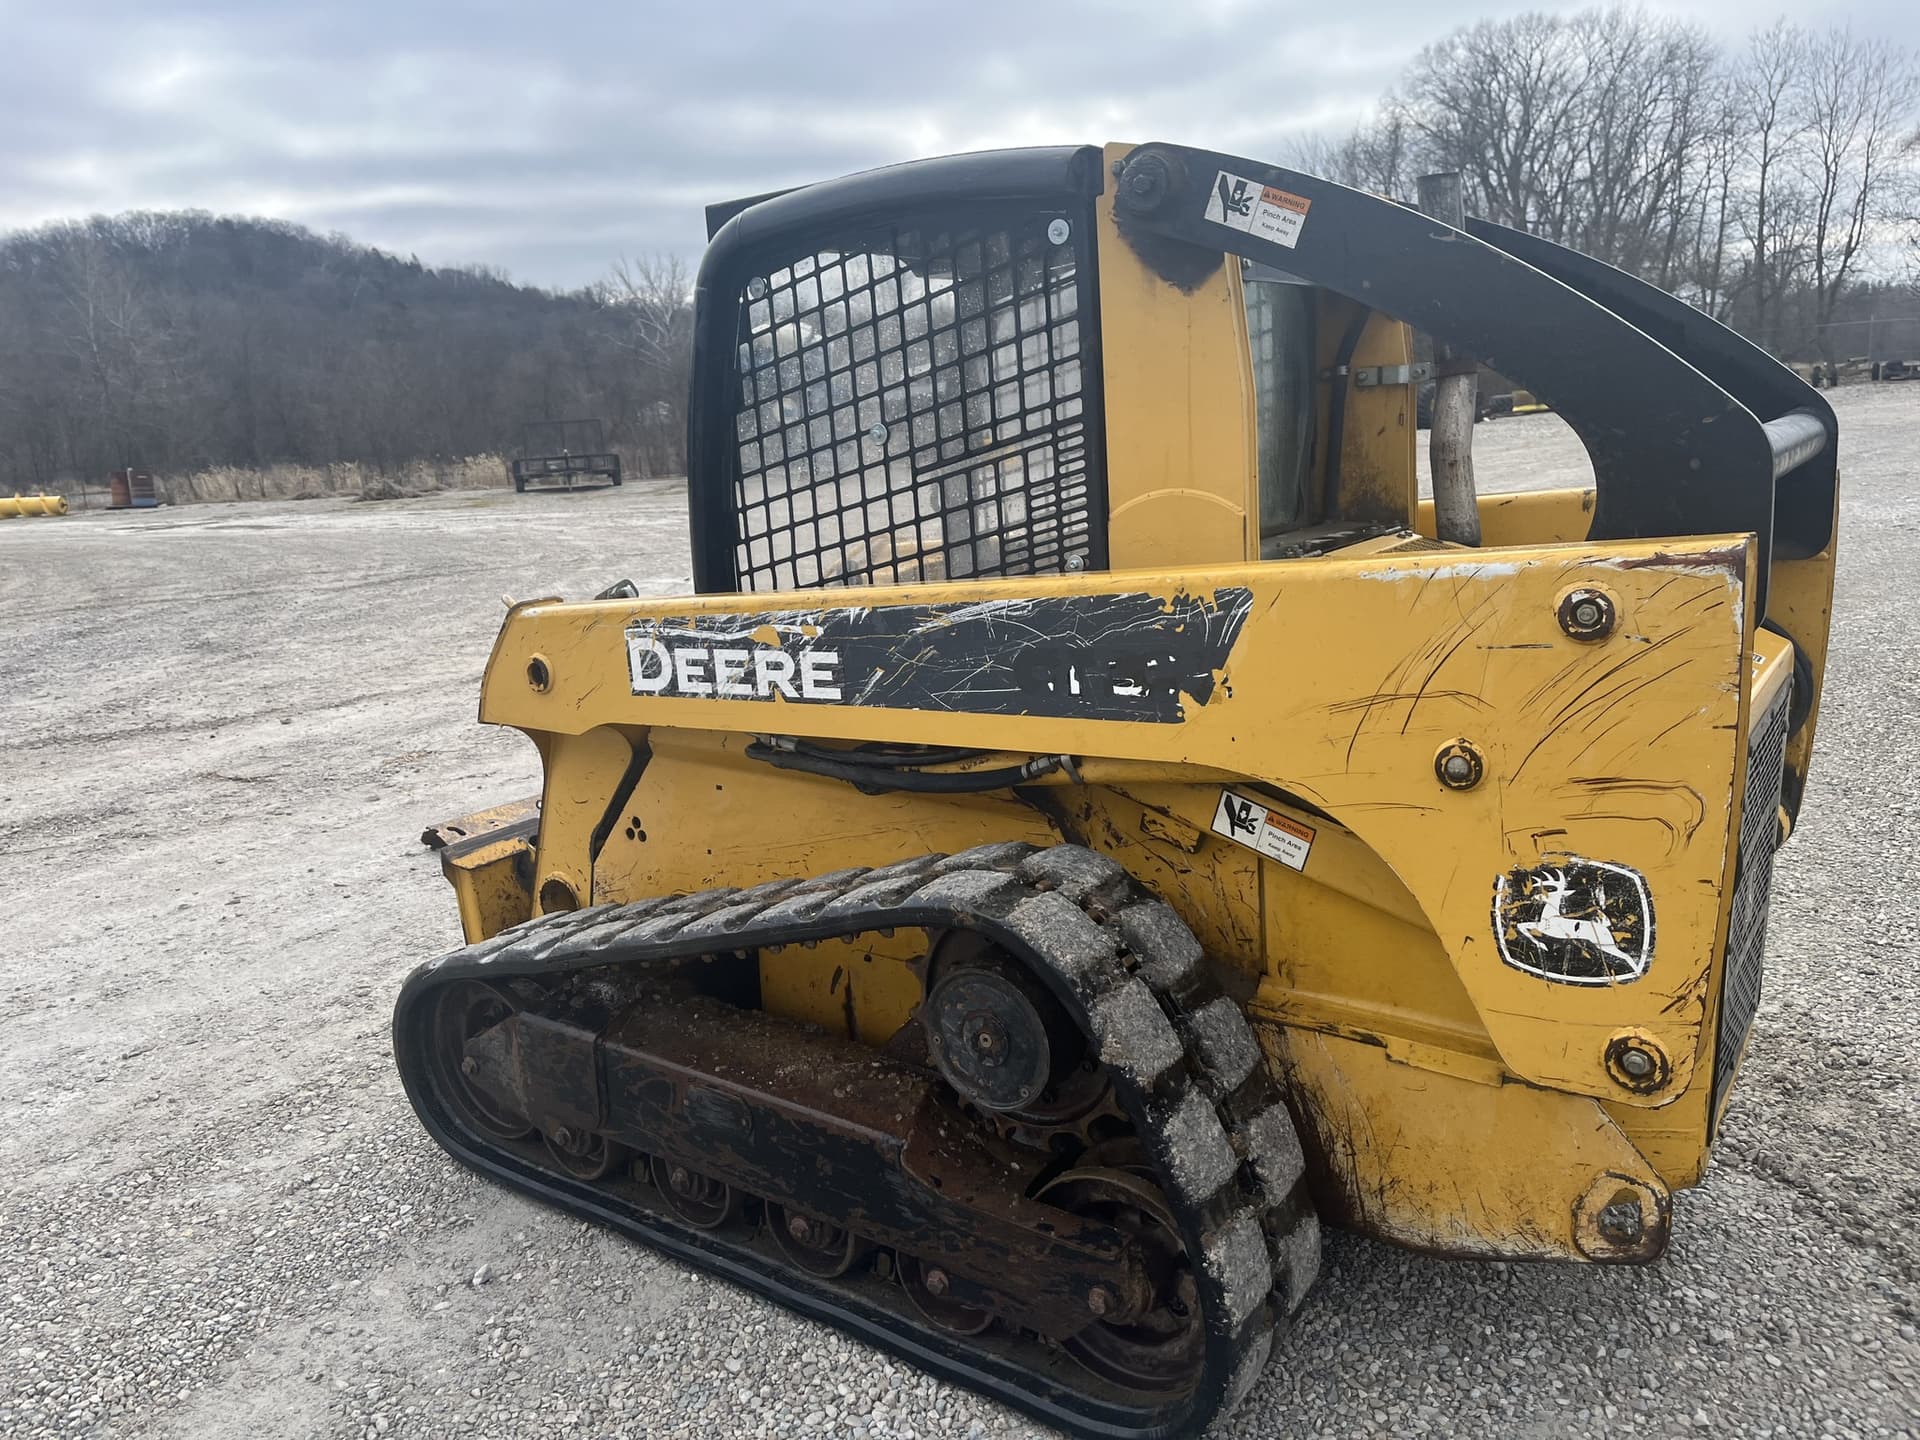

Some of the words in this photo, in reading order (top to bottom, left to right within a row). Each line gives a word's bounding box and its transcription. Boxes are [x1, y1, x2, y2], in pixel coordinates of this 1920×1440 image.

[1271, 193, 1306, 210] WARNING
[1262, 208, 1281, 220] Pinch
[1281, 215, 1297, 226] Area
[628, 636, 842, 700] DEERE
[1275, 820, 1309, 838] WARNING
[1267, 830, 1286, 844] Pinch
[1286, 840, 1302, 851] Area
